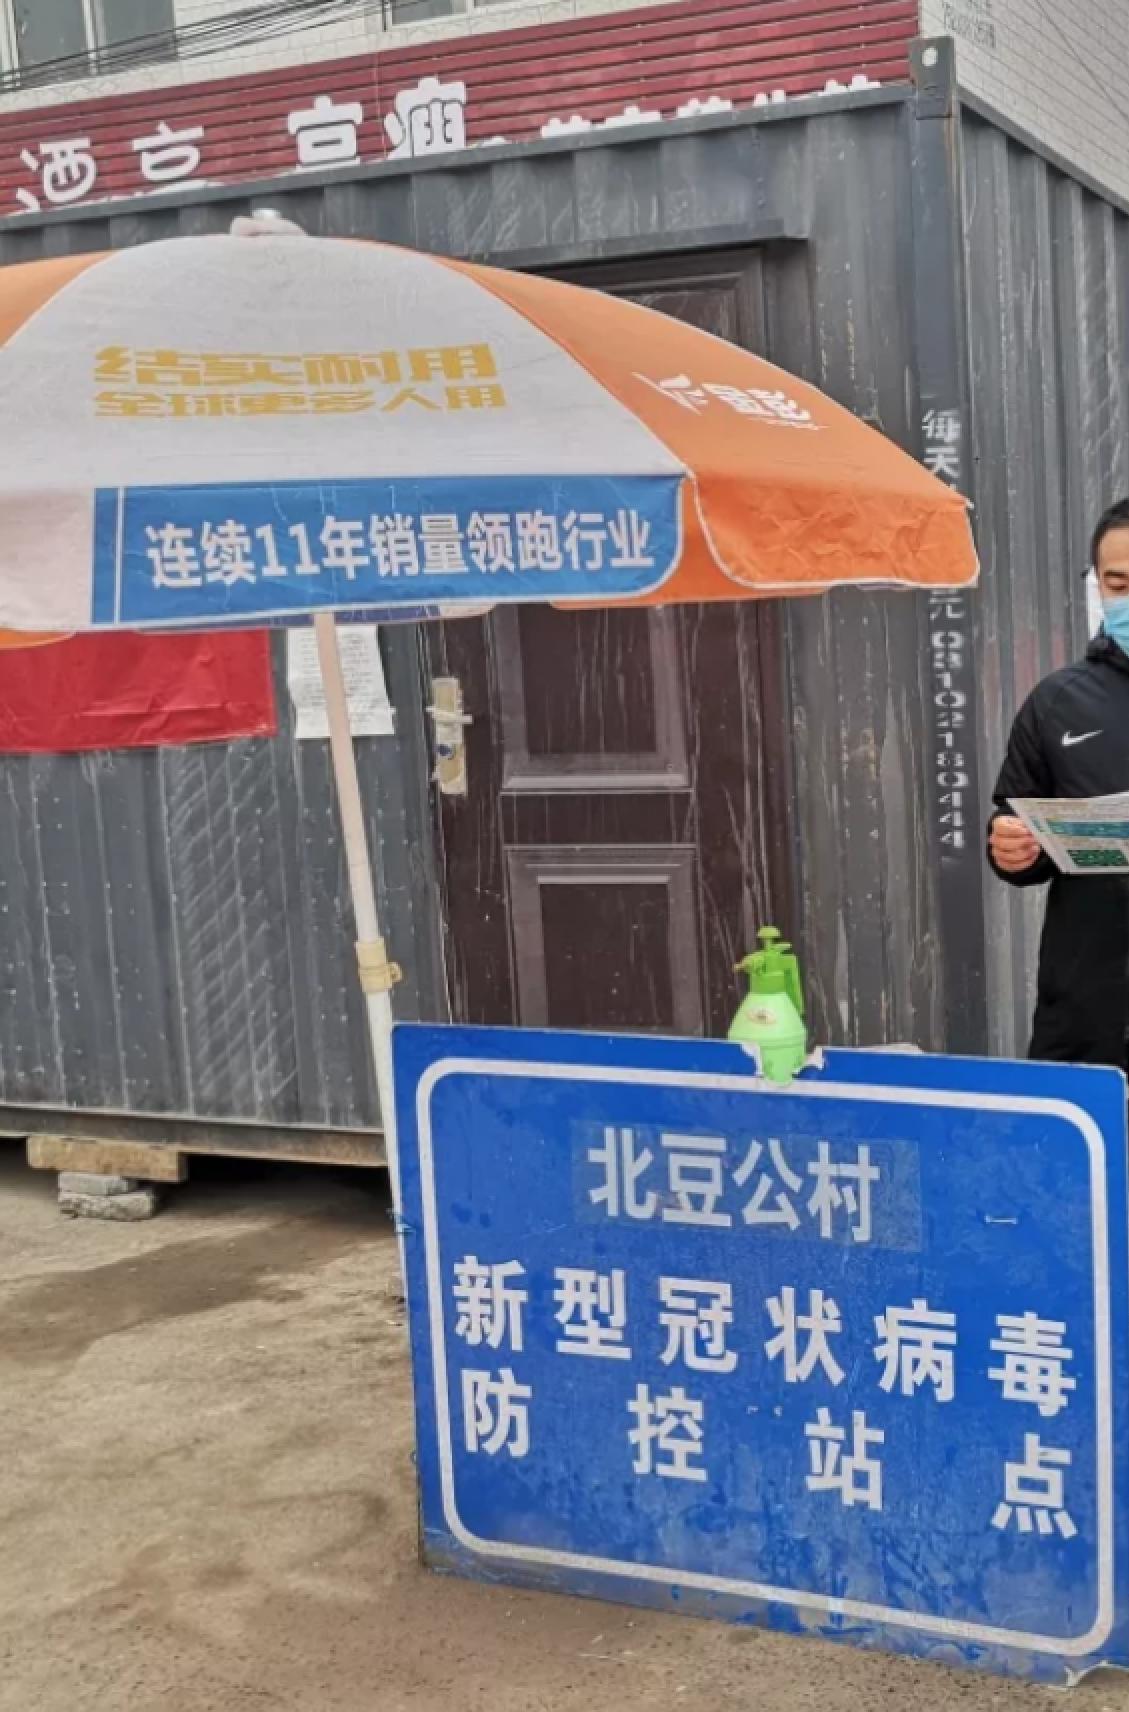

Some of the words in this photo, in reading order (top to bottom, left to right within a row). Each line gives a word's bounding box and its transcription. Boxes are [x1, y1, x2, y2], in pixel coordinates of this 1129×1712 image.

[94, 384, 506, 418] 全球更多人用
[95, 343, 498, 384] 结实耐用
[145, 509, 655, 589] 连续11年销量领跑行业
[588, 1127, 880, 1242] 北豆公村
[452, 1256, 1077, 1417] 新型冠状病毒
[460, 1367, 1079, 1540] 防控站点
